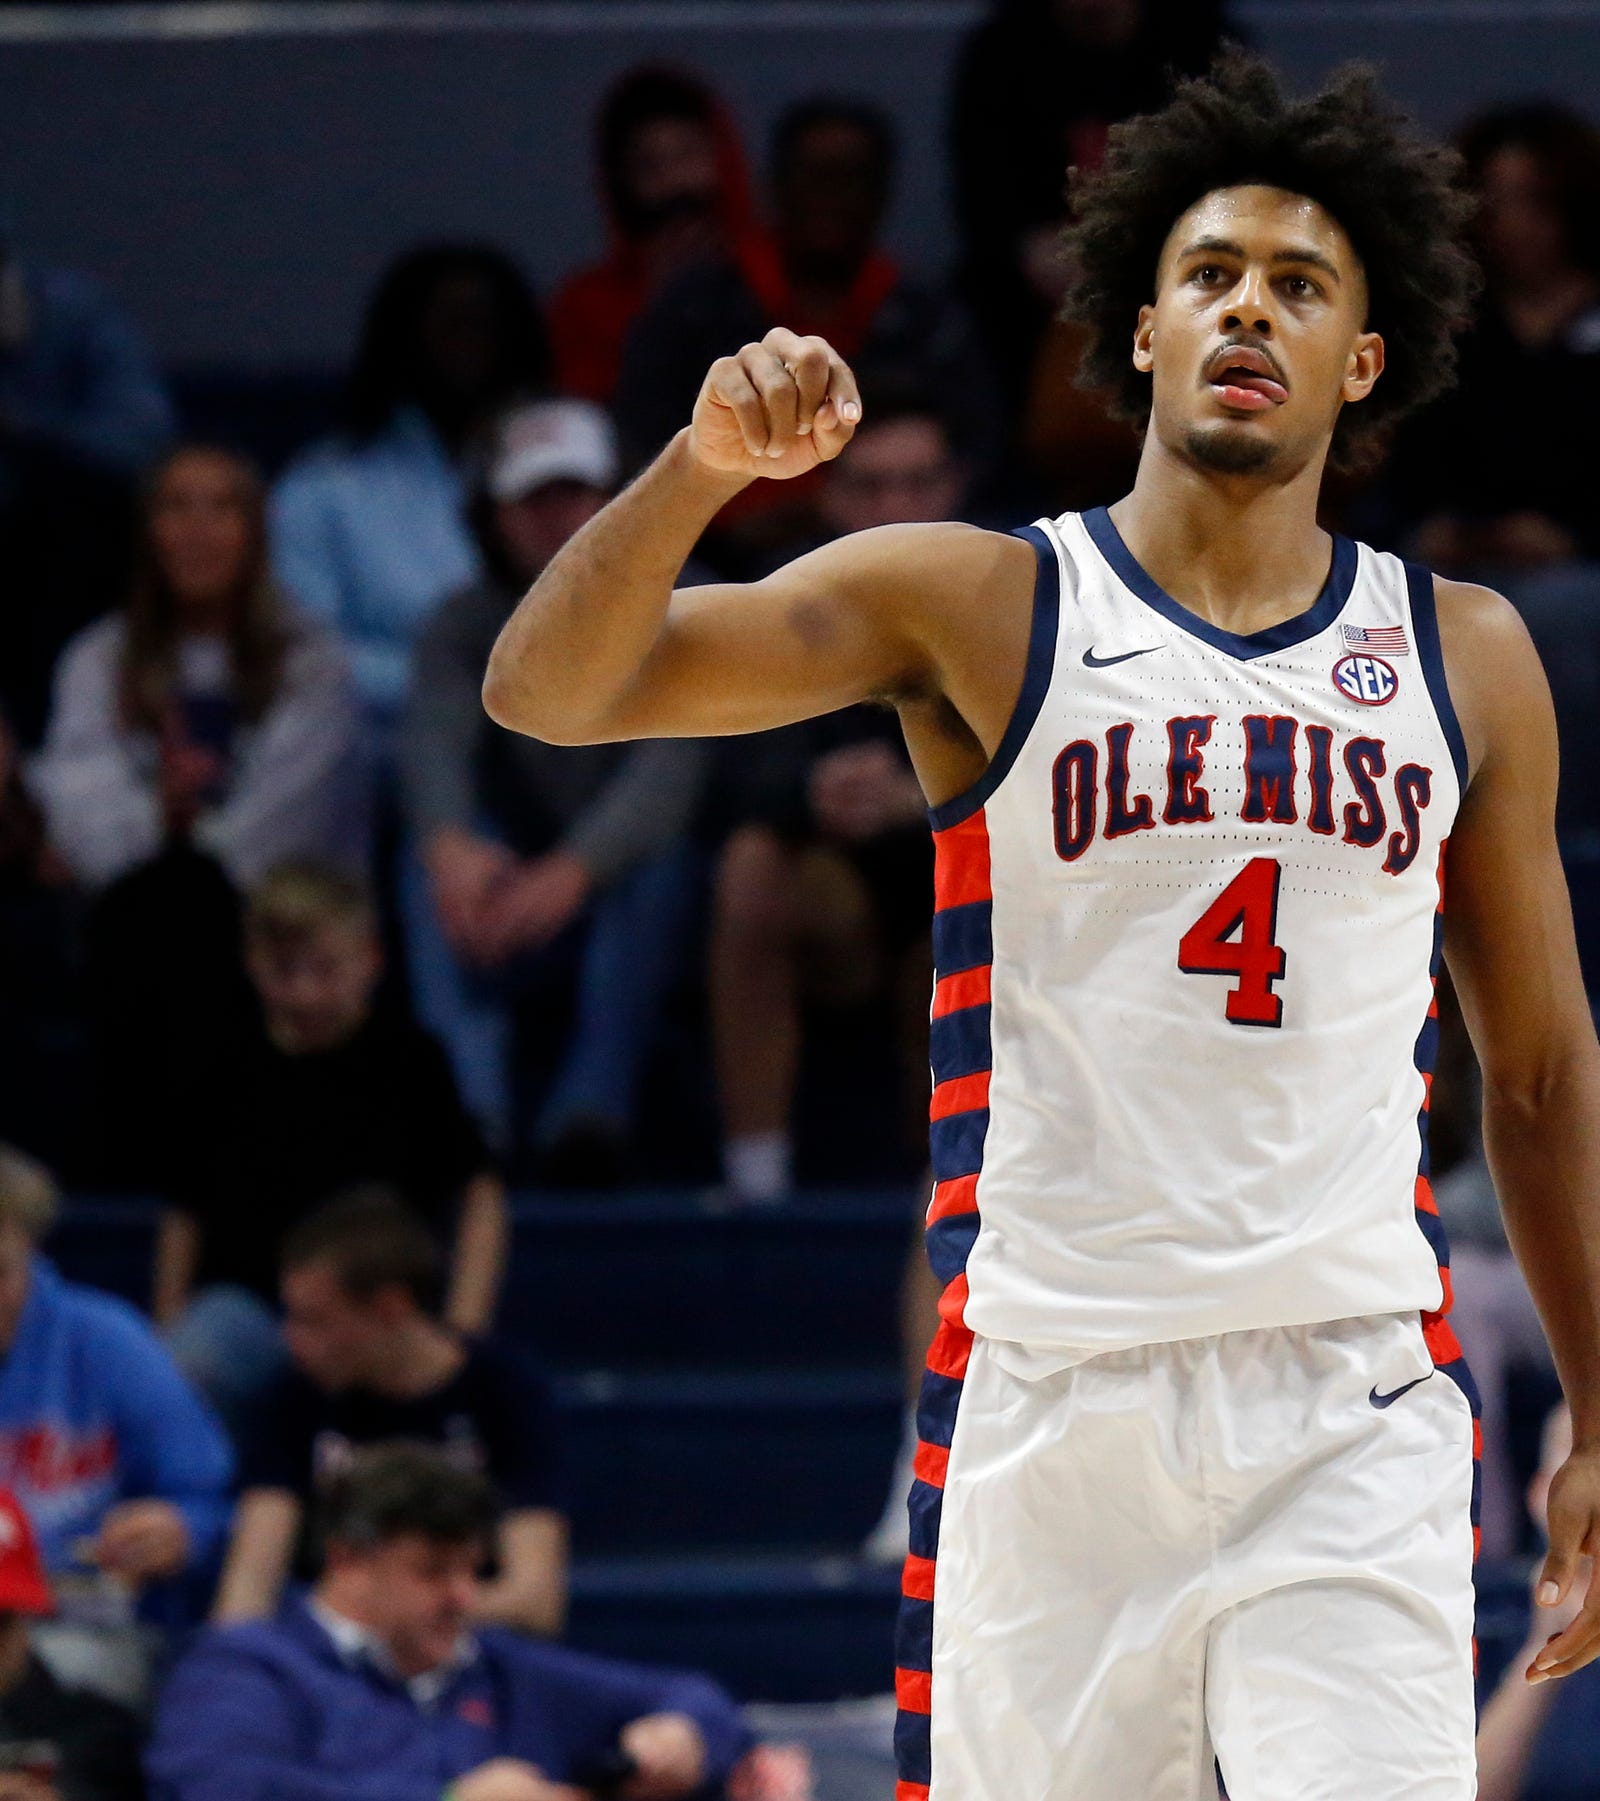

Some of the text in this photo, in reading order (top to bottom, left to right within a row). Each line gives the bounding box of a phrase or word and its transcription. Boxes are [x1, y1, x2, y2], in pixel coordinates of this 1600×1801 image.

[1337, 657, 1394, 701] SEC
[1051, 714, 1432, 875] OLE MISS
[1178, 857, 1287, 1027] 4
